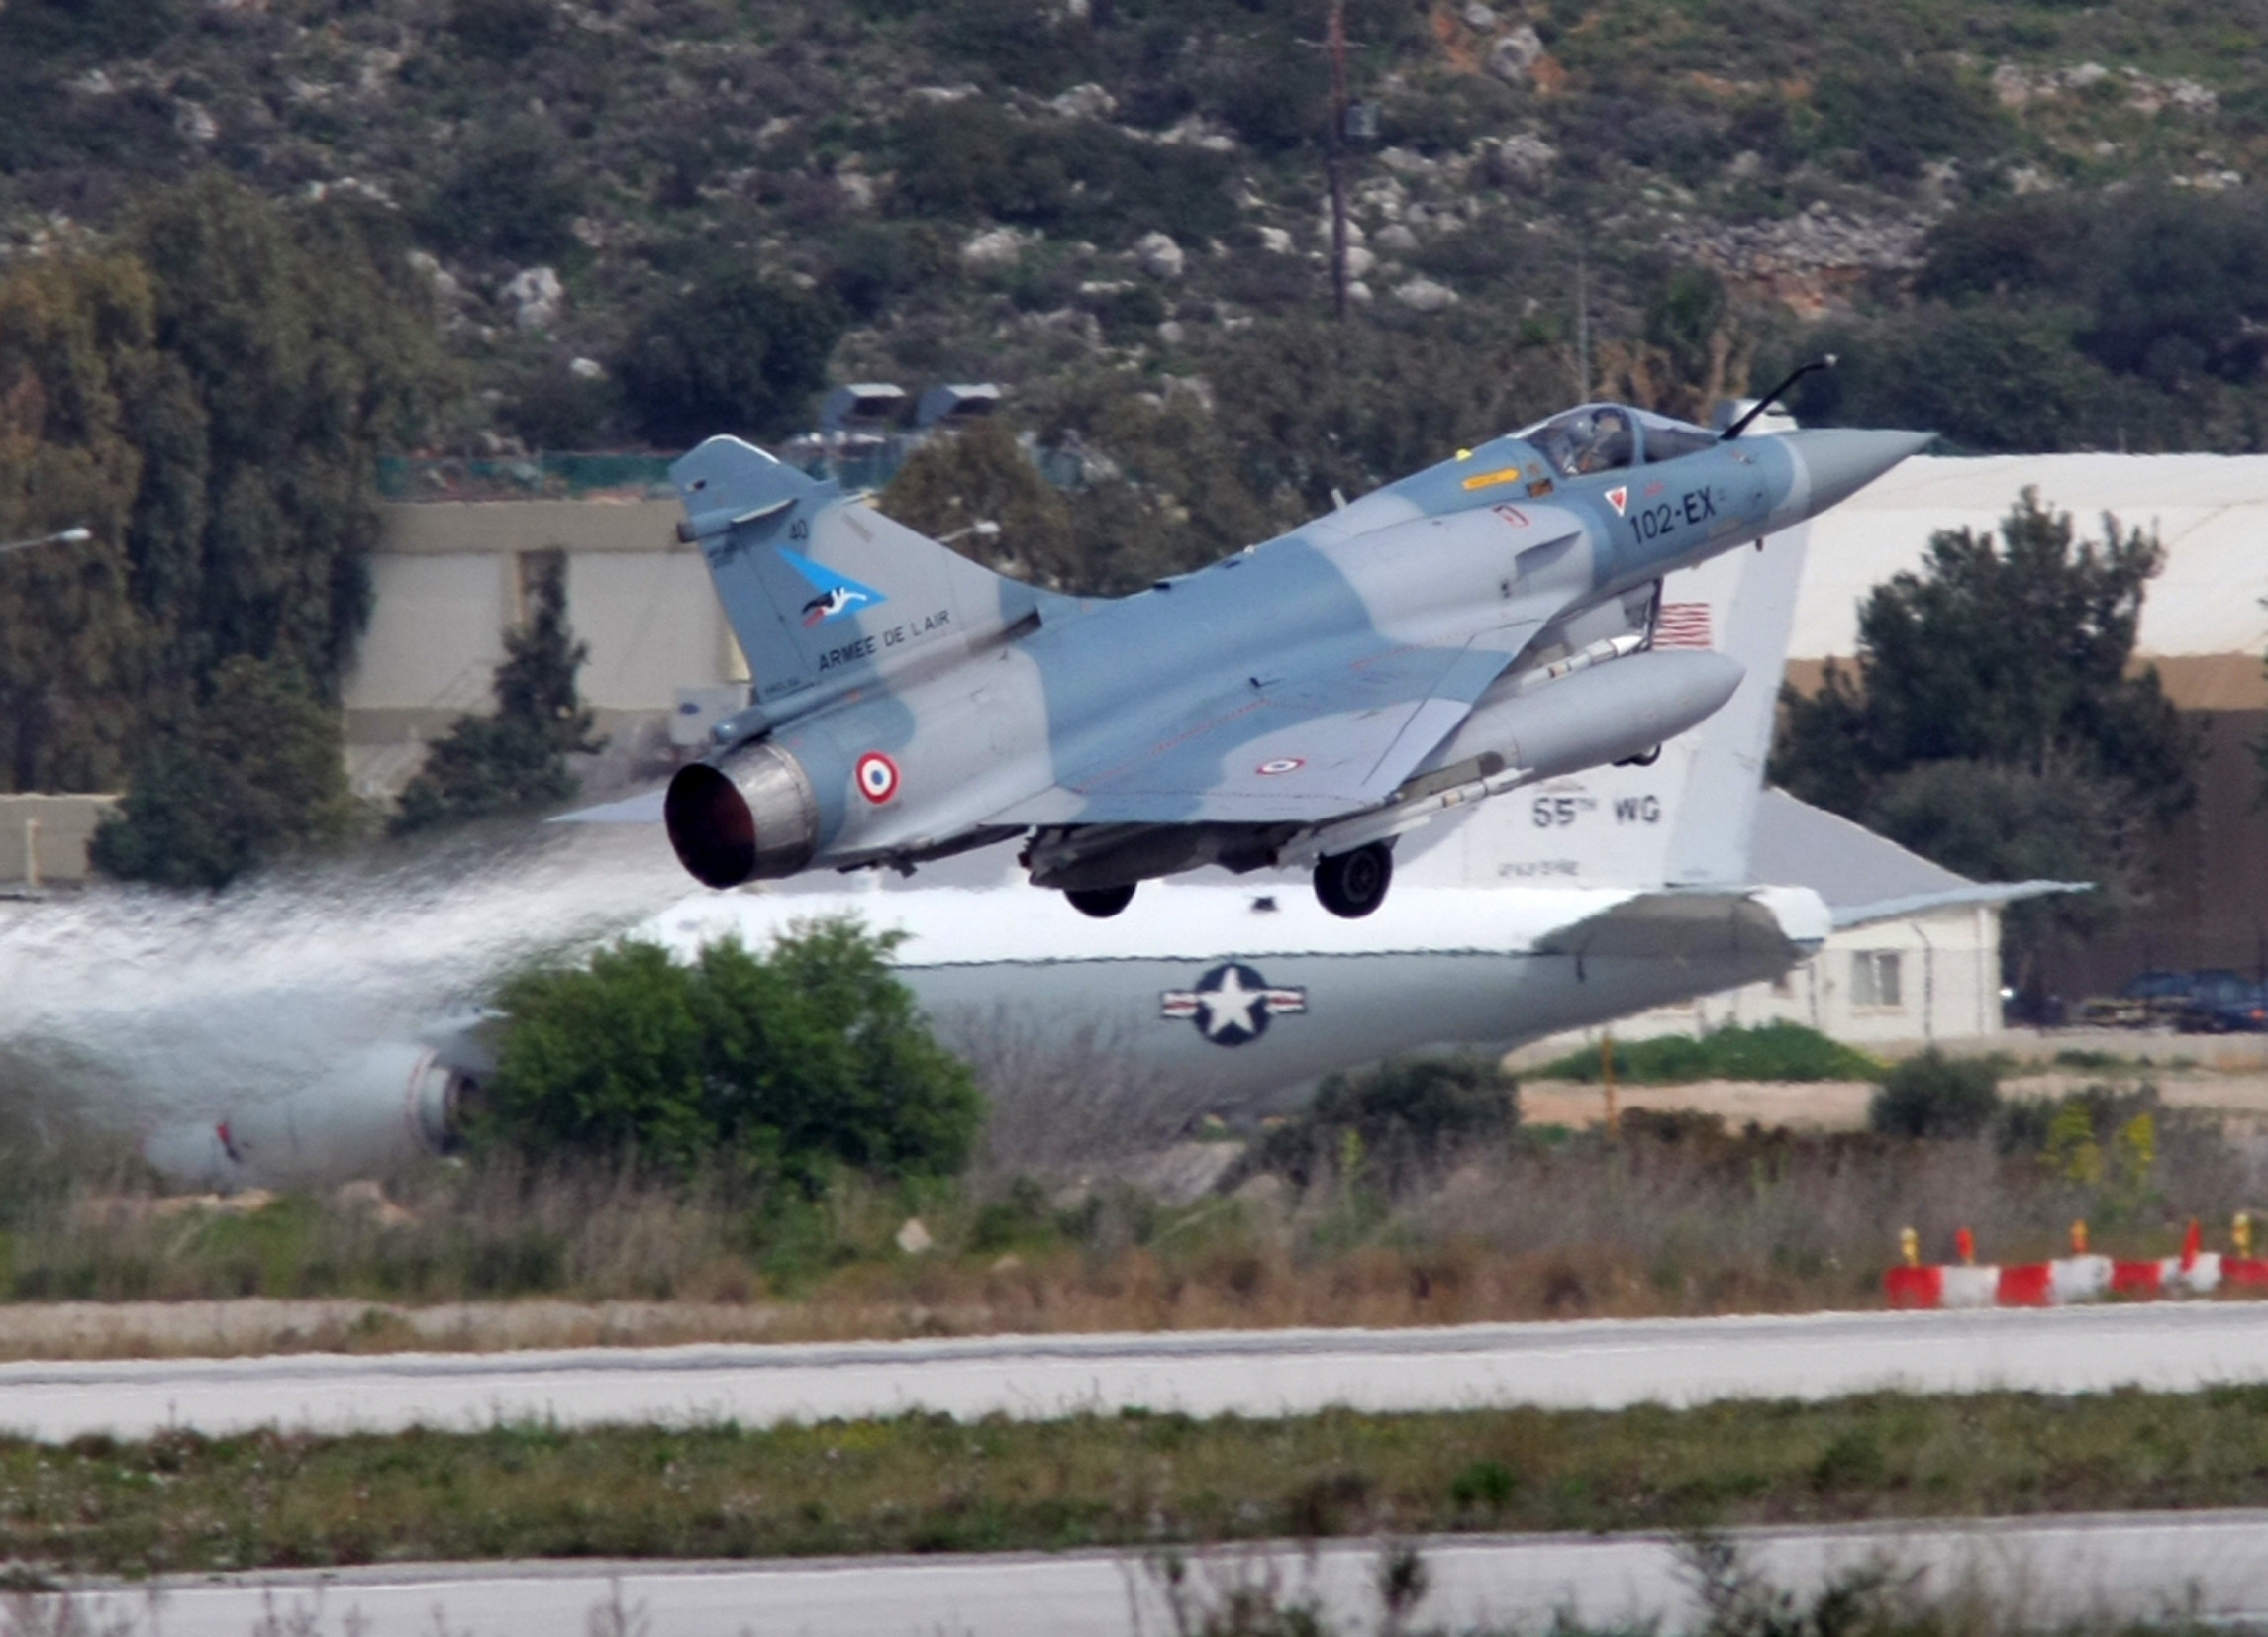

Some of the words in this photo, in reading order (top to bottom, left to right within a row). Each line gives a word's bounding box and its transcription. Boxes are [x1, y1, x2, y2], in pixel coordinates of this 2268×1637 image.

[789, 519, 808, 539] 40
[1631, 485, 1715, 543] 102-EX
[820, 635, 876, 671] ARMEE
[884, 626, 905, 646] DE
[1614, 795, 1660, 823] WG
